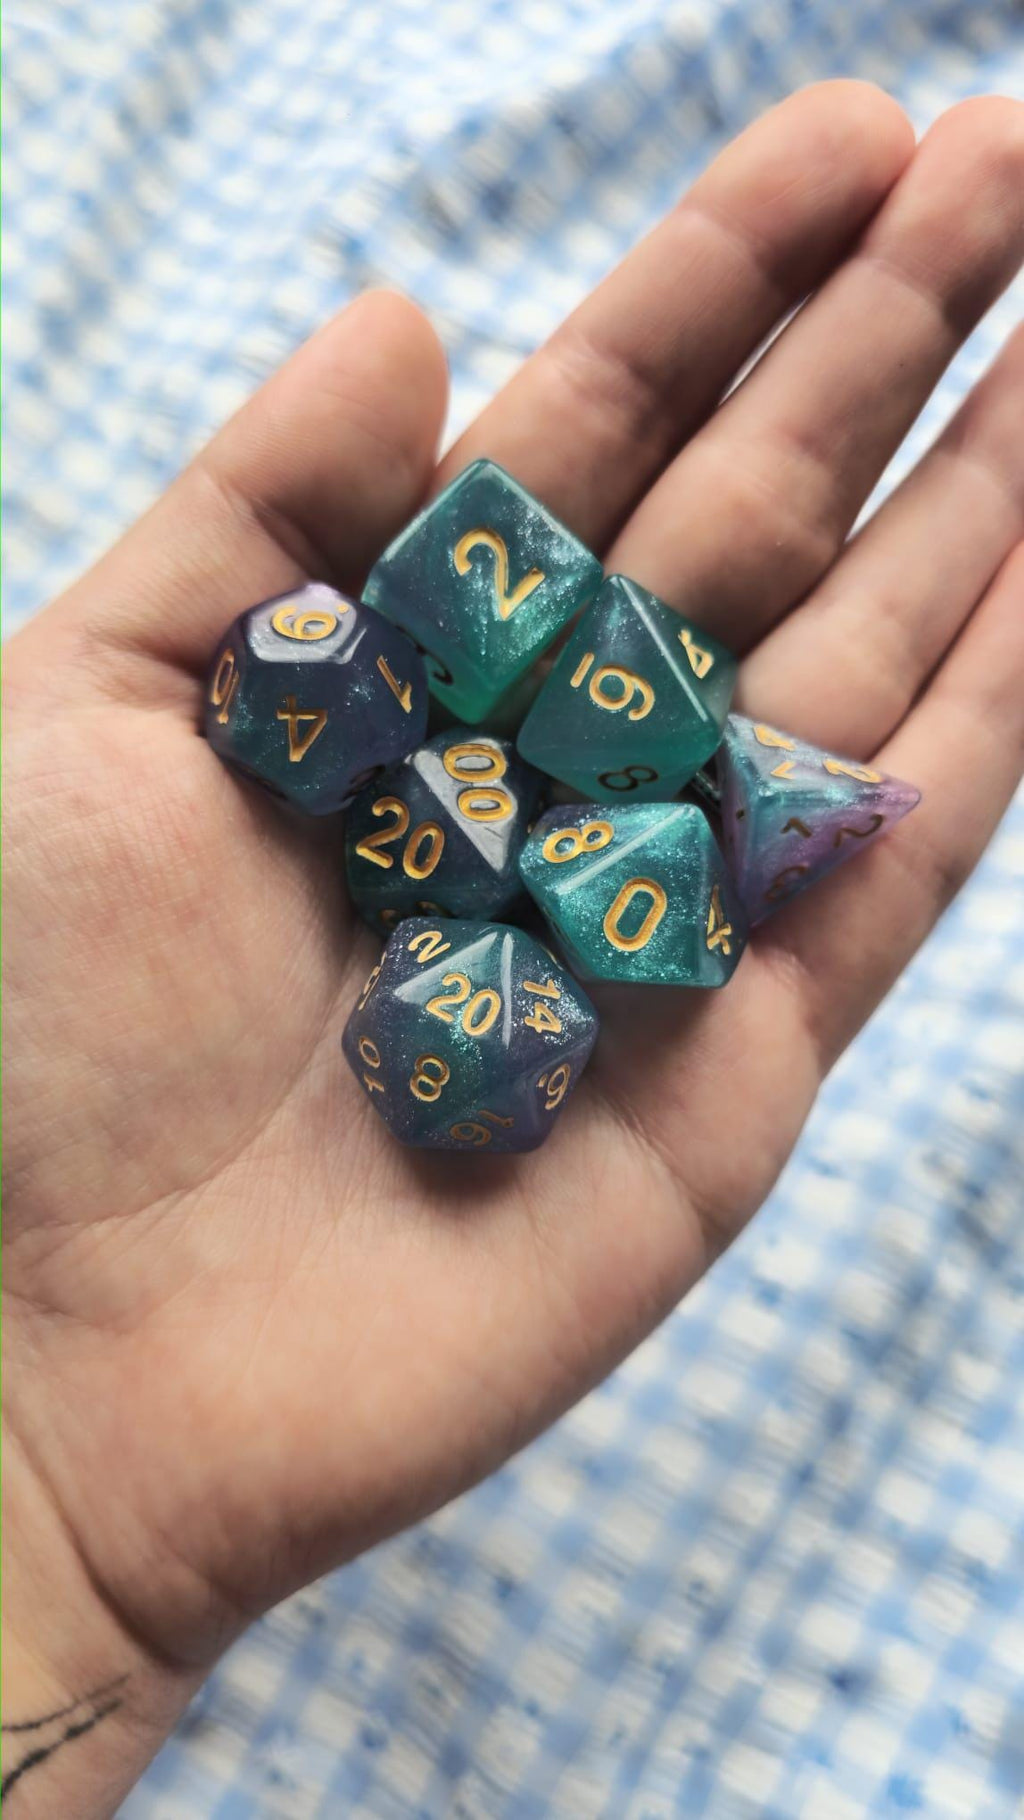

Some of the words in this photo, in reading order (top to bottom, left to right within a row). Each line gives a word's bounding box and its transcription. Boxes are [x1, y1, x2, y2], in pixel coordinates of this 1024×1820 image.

[454, 527, 545, 621] 2
[678, 628, 714, 679] 4
[376, 655, 412, 714] 1
[277, 695, 329, 762] 4
[443, 743, 514, 823] 00
[597, 765, 658, 792] 8
[355, 796, 445, 880] 20
[542, 820, 614, 863] 8
[603, 876, 667, 952] 0
[707, 885, 732, 955] 4
[408, 930, 451, 964] 2
[426, 972, 501, 1037] 20
[523, 979, 562, 1034] 14
[359, 1035, 385, 1093] 10
[410, 1054, 450, 1102] 8
[450, 1109, 515, 1147] 16
